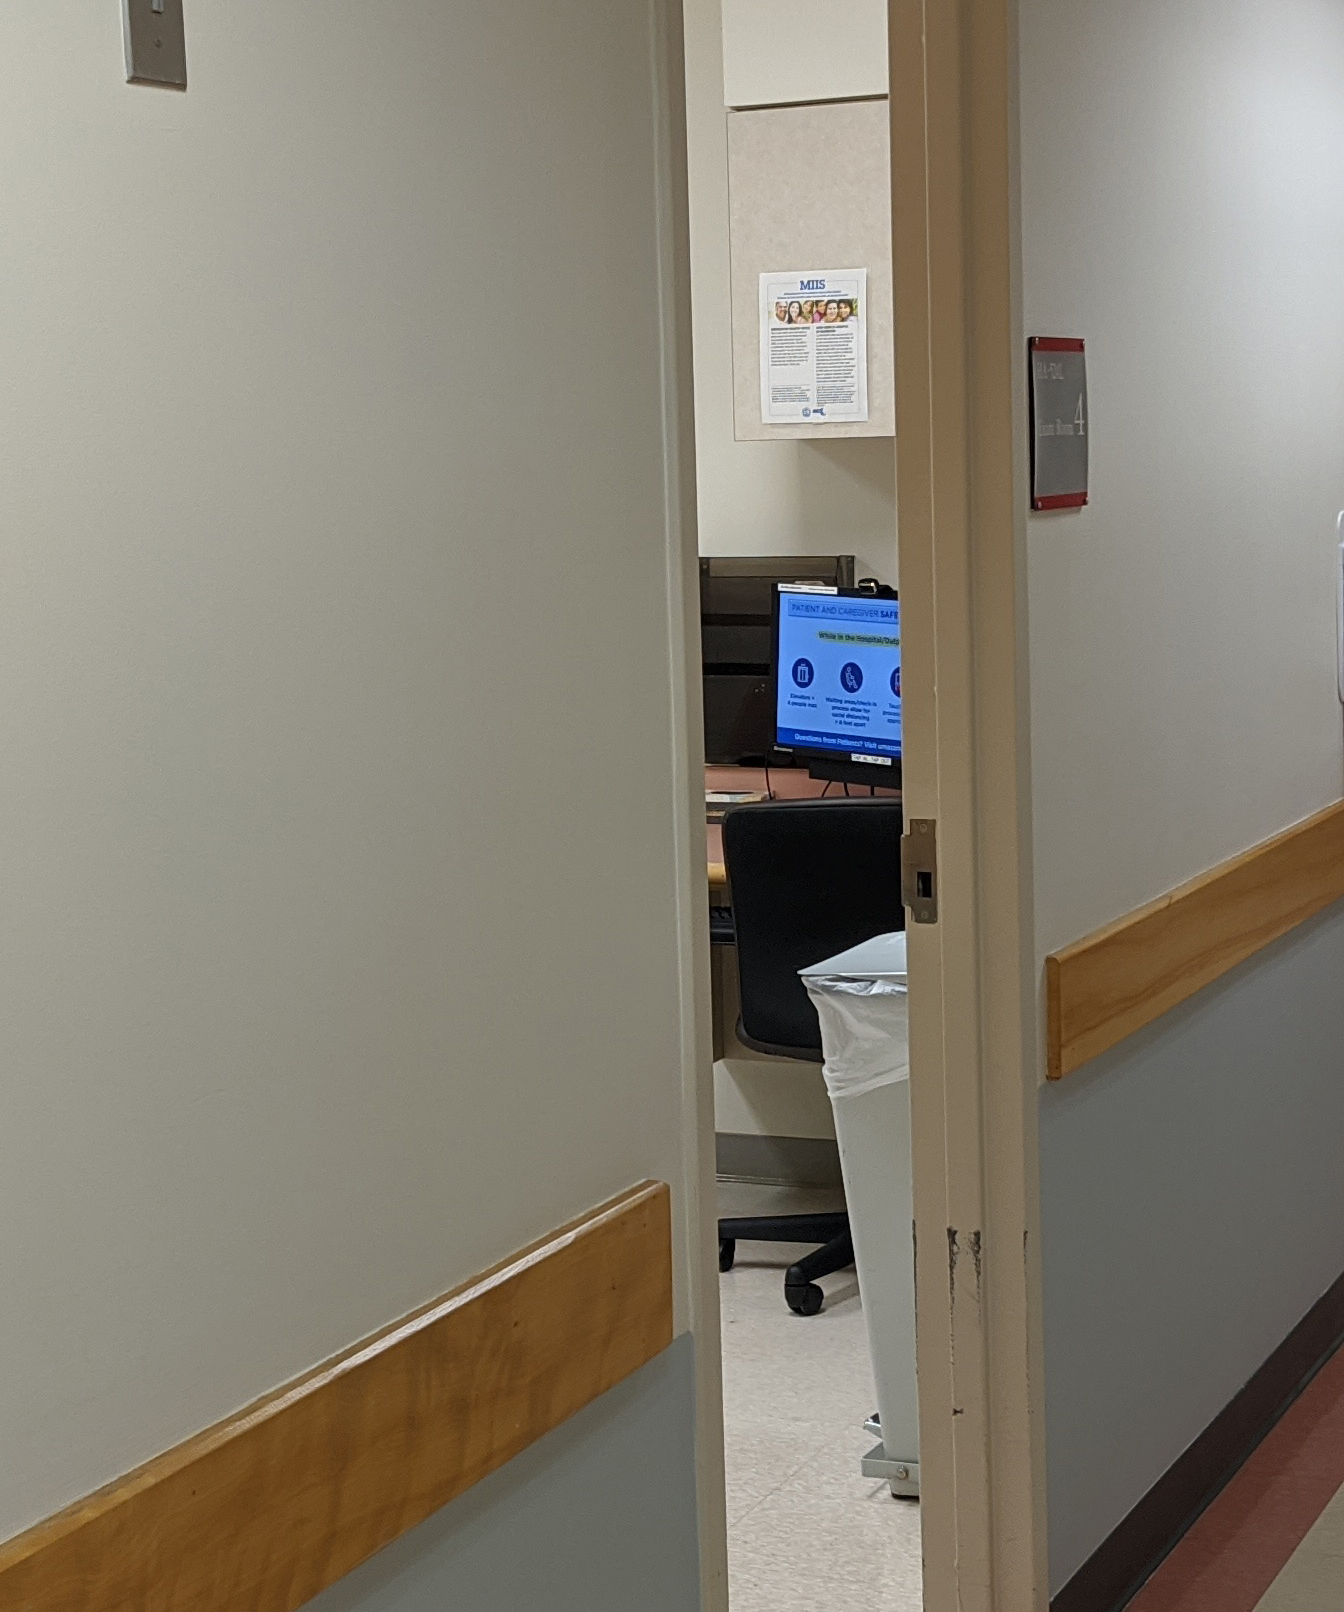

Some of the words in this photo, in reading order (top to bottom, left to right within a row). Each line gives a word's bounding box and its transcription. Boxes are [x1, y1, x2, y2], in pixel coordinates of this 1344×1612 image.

[800, 280, 826, 290] MIIS
[1074, 393, 1085, 435] 4
[791, 604, 819, 613] PATIENT
[821, 606, 837, 615] AND
[838, 607, 878, 618] CAREGIVER
[844, 633, 855, 641] the
[823, 736, 836, 744] from
